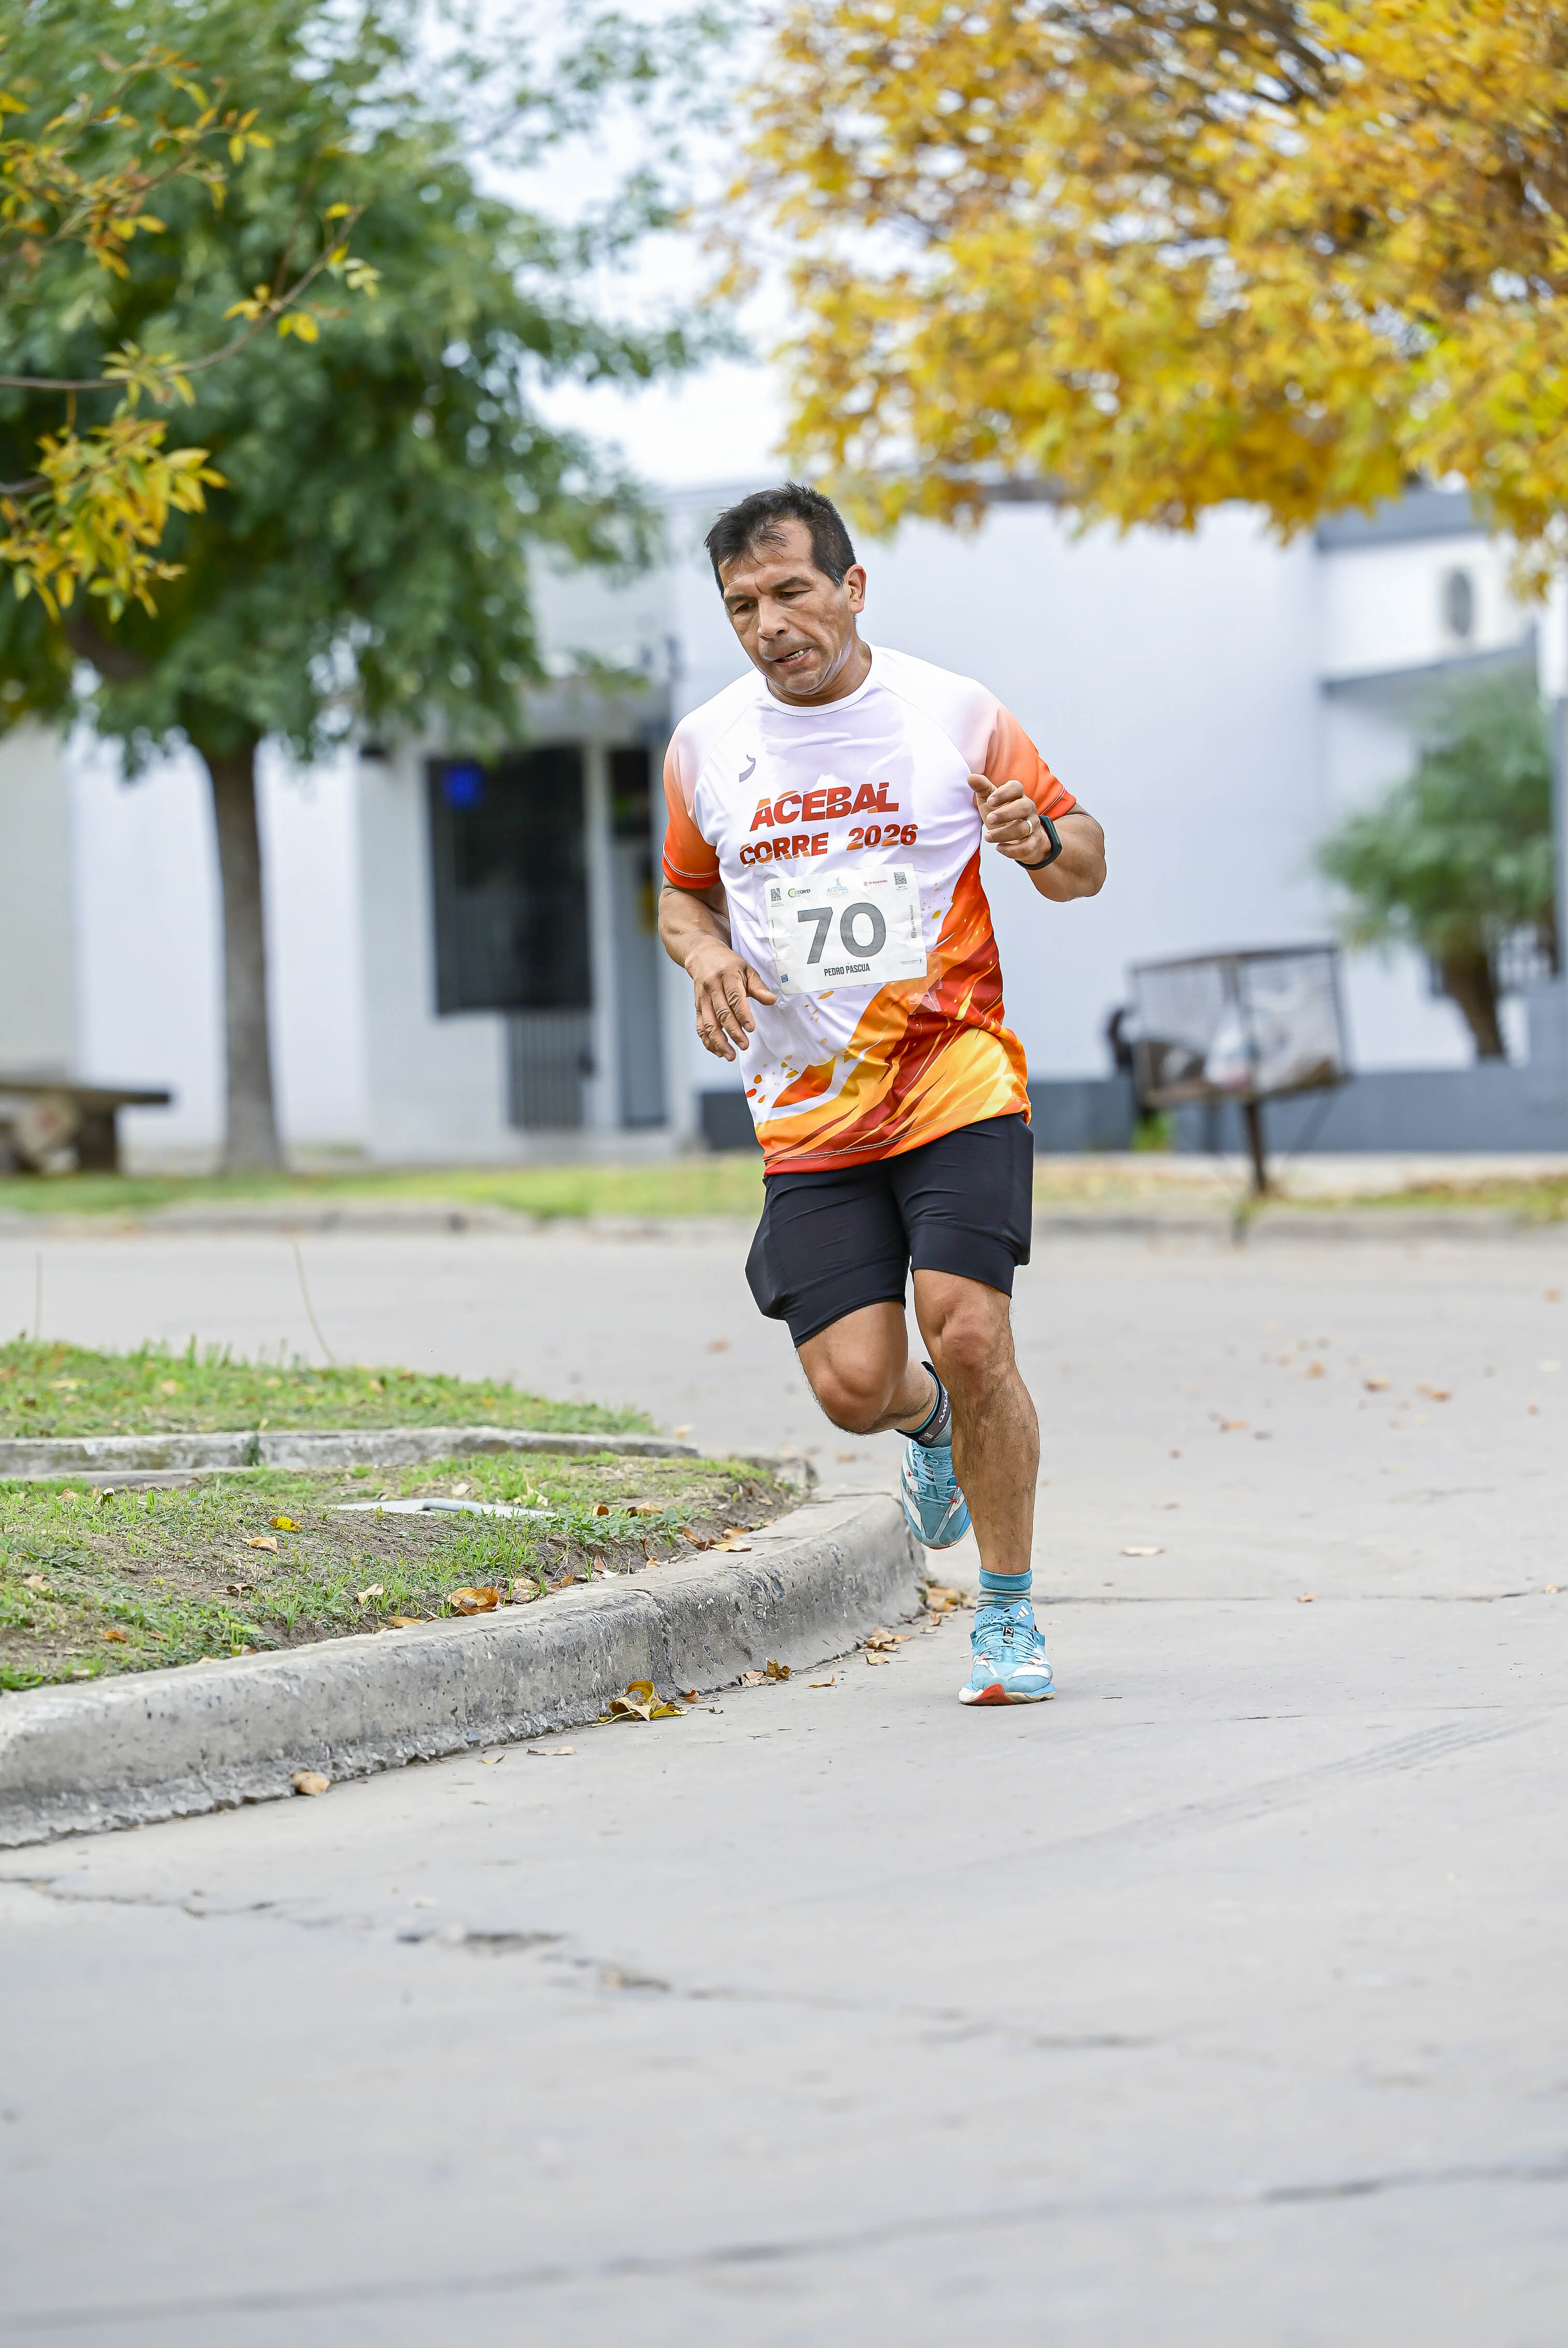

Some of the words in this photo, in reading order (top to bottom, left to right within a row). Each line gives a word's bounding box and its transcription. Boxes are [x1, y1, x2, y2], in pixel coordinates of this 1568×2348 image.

[749, 782, 899, 832] ACEBAL
[739, 832, 829, 866] CORRE
[846, 823, 918, 851] 2026
[797, 902, 886, 965] 70
[824, 967, 845, 976] PEDRO
[846, 963, 870, 973] PASCUA
